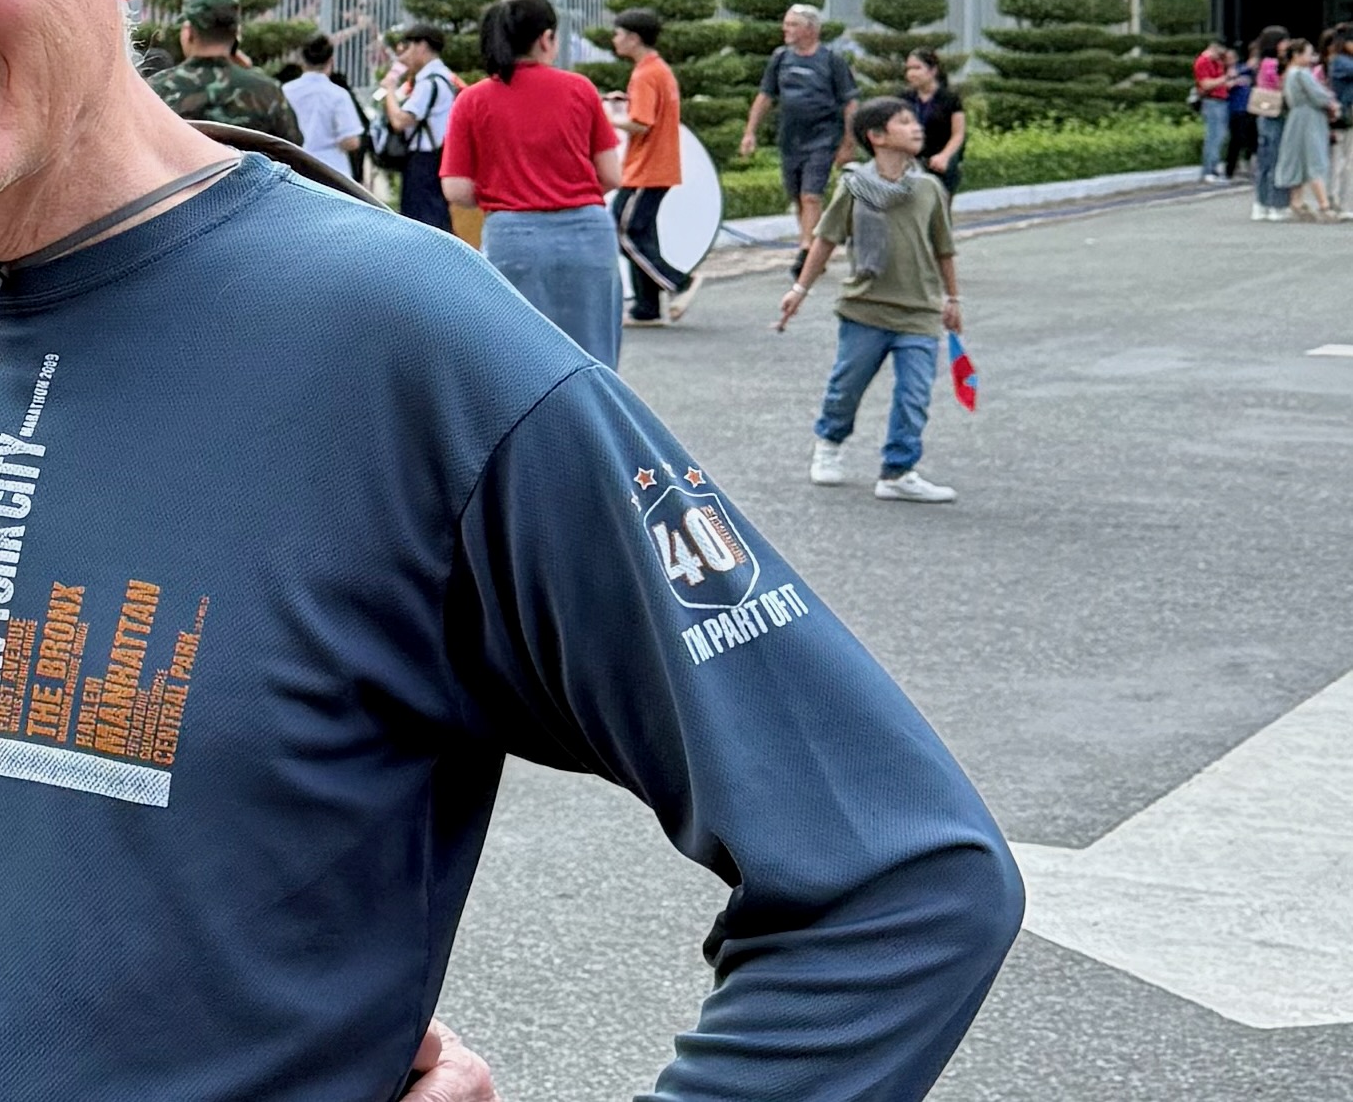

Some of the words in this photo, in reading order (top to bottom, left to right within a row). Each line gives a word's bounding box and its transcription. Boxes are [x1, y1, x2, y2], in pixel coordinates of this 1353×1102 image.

[19, 380, 50, 437] MARATHON
[39, 354, 60, 379] 2009
[652, 507, 736, 586] 40
[3, 617, 26, 681] AVENUE
[36, 581, 85, 678] BRONX
[170, 631, 200, 679] PARK
[681, 624, 714, 665] I'M
[703, 600, 768, 653] PART
[759, 590, 792, 627] OF
[778, 583, 809, 617] IT
[94, 579, 160, 755] MANHATTAN
[26, 684, 62, 737] THE
[76, 676, 104, 747] HARLEM
[133, 688, 150, 727] AVENUE
[153, 685, 188, 765] CENTRAL
